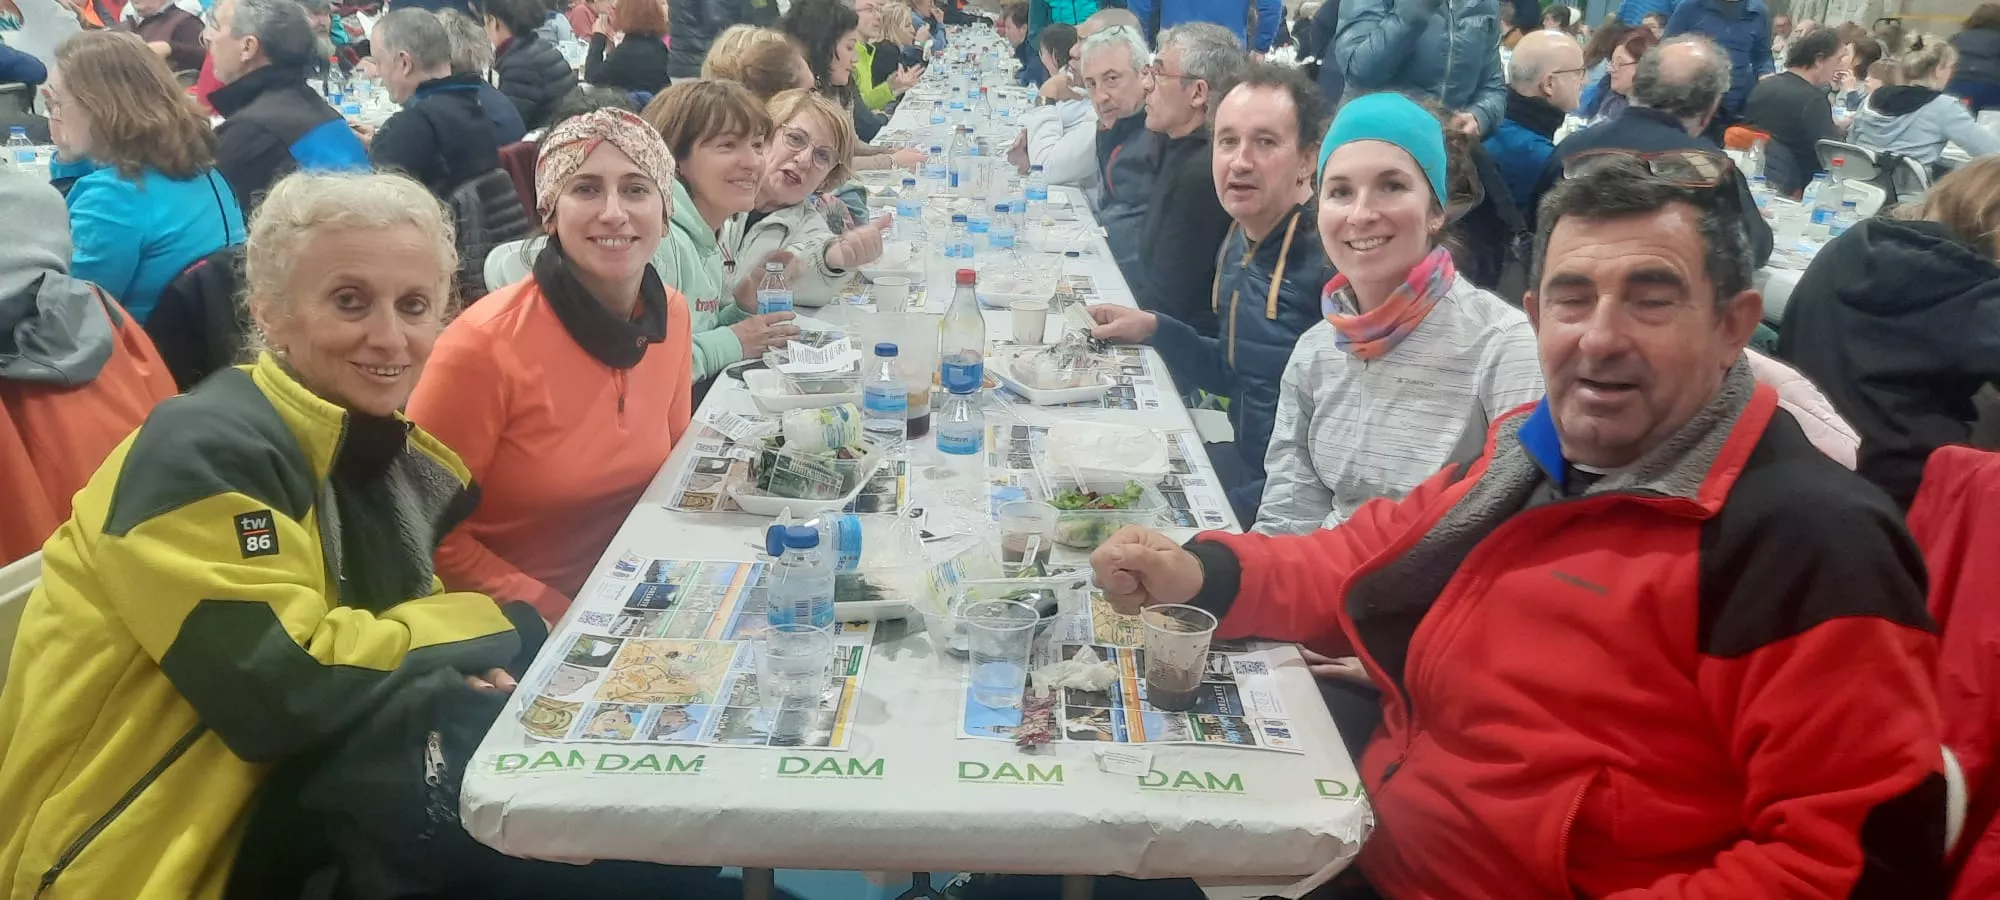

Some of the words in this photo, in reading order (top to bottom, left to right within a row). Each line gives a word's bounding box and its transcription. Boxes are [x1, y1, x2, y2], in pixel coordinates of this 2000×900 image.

[240, 517, 267, 530] tw
[246, 534, 271, 552] 86
[594, 753, 706, 772] DAM
[776, 756, 885, 776] DAM
[958, 761, 1064, 782] DAM
[1137, 769, 1244, 791] DAM
